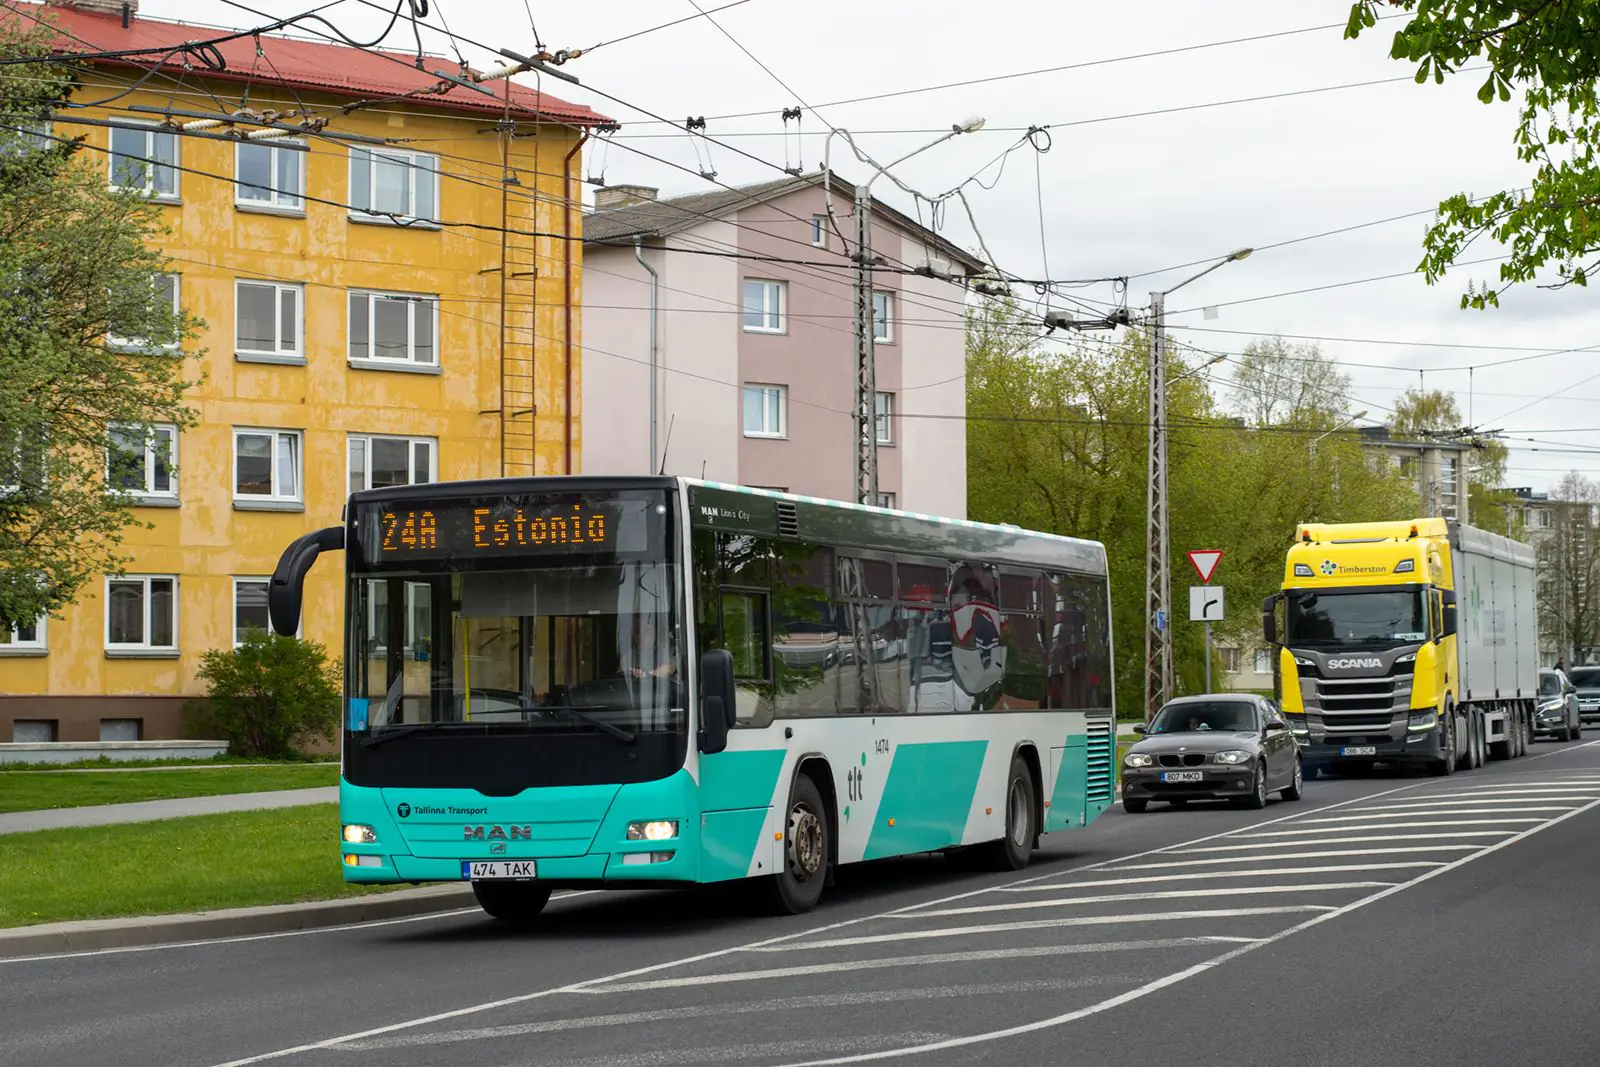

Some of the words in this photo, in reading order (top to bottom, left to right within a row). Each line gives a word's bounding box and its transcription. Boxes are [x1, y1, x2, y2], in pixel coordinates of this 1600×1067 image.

[701, 506, 718, 516] MAN
[383, 511, 436, 550] 24A
[474, 504, 604, 547] Estonia
[1339, 565, 1386, 574] Timberston
[1328, 658, 1383, 669] SCANIA
[875, 739, 889, 755] 1474
[1167, 772, 1180, 781] 807
[1182, 772, 1200, 781] MKD
[414, 806, 446, 815] Tallinna
[447, 806, 488, 816] Transport
[463, 824, 531, 841] MAN
[473, 863, 496, 876] 474
[503, 862, 532, 876] TAK
